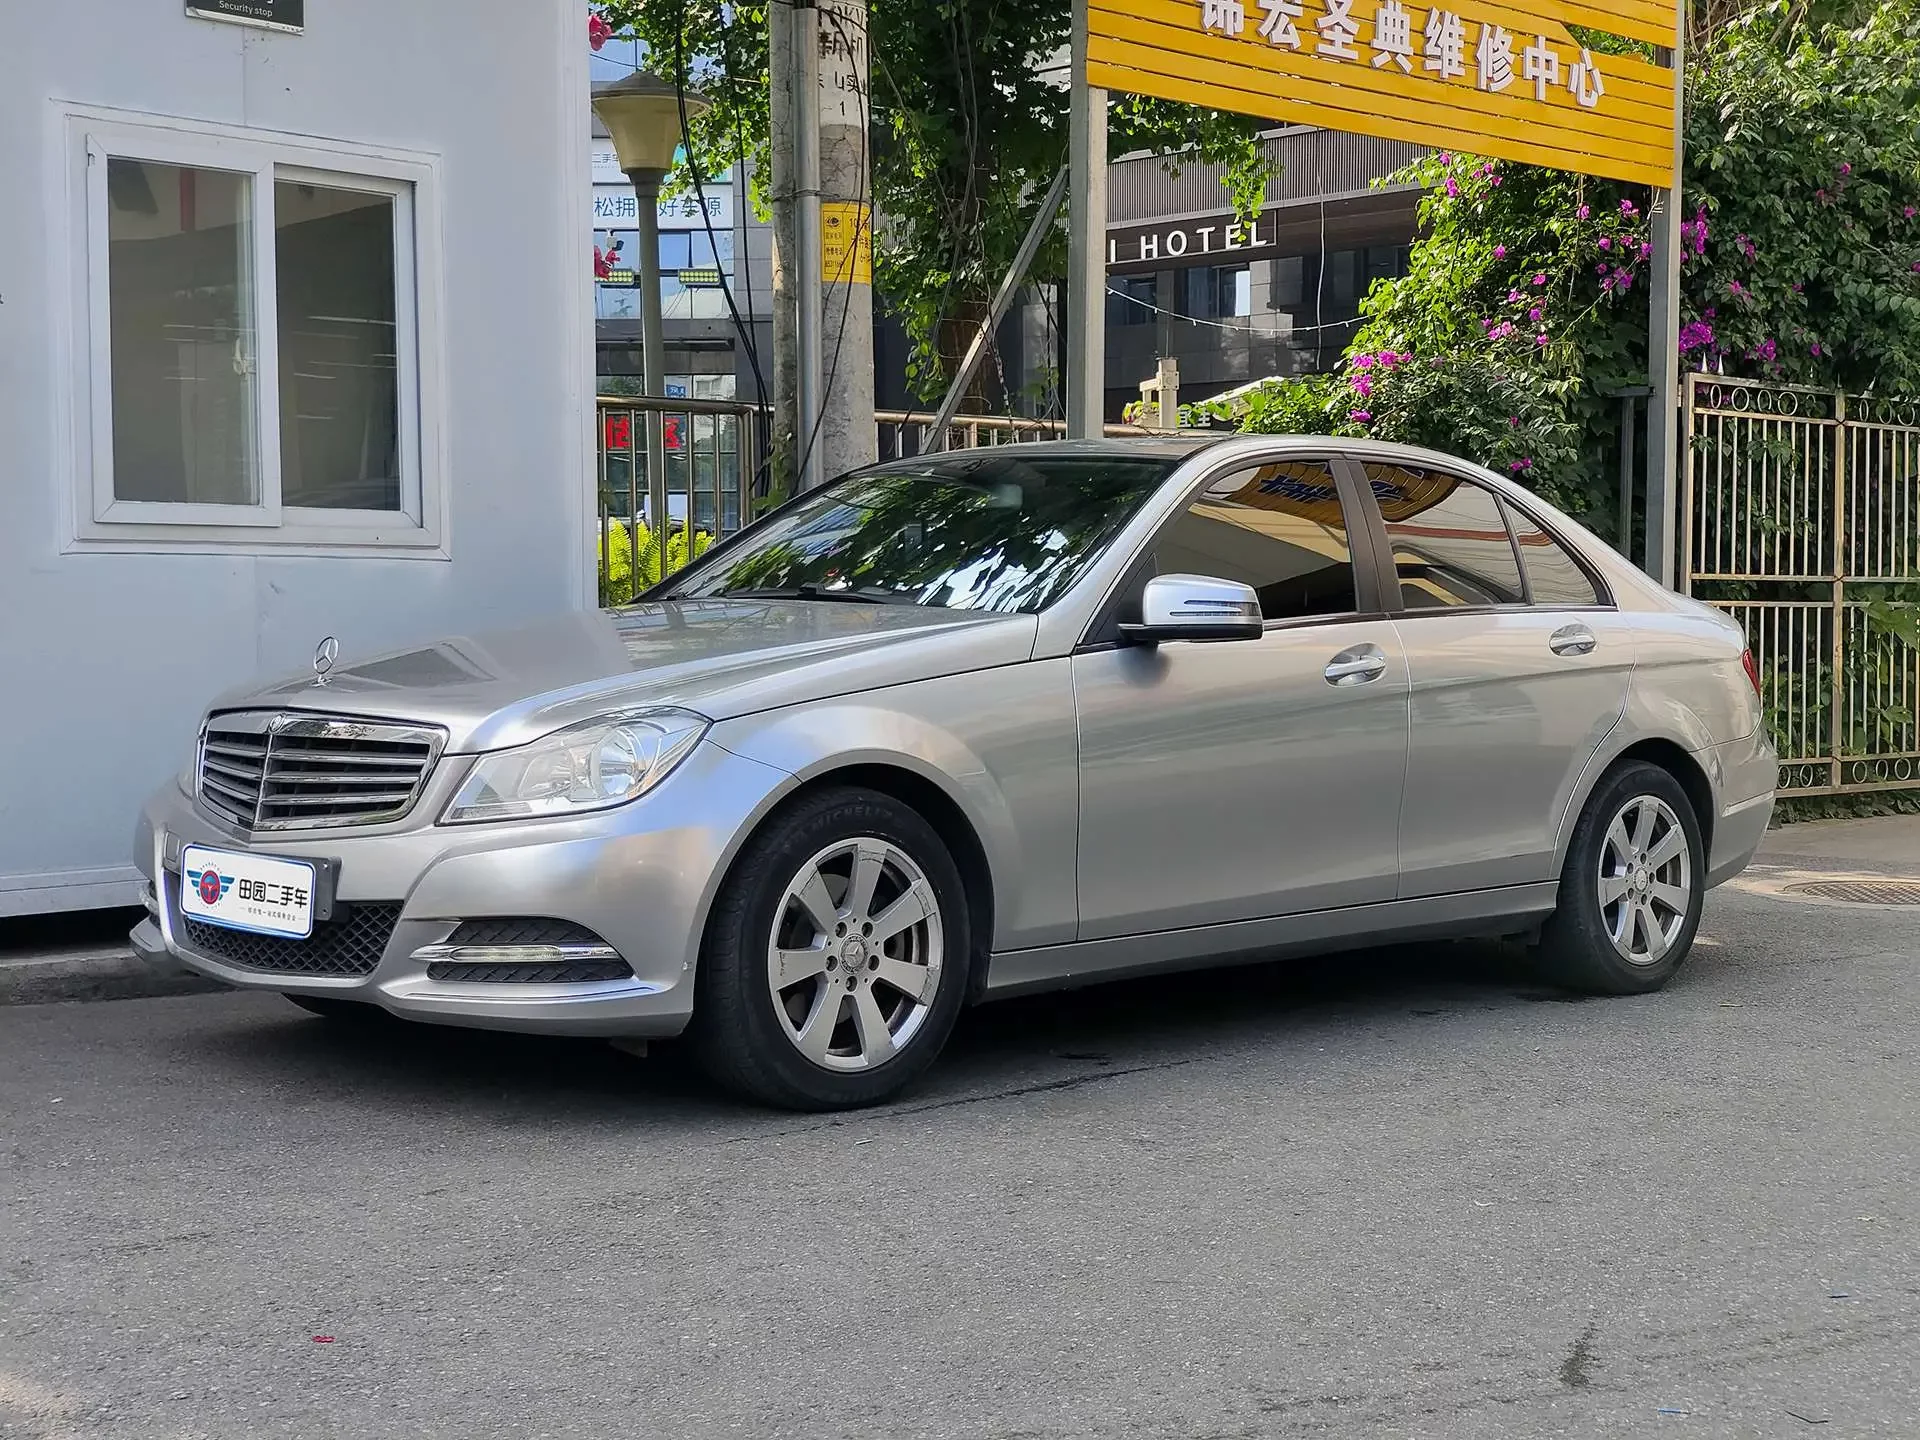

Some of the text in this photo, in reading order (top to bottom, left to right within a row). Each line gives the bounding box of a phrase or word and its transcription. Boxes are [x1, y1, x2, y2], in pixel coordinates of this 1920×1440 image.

[219, 0, 273, 17] Security stop
[1140, 221, 1267, 260] HOTEL
[238, 878, 308, 909] 田园二手车
